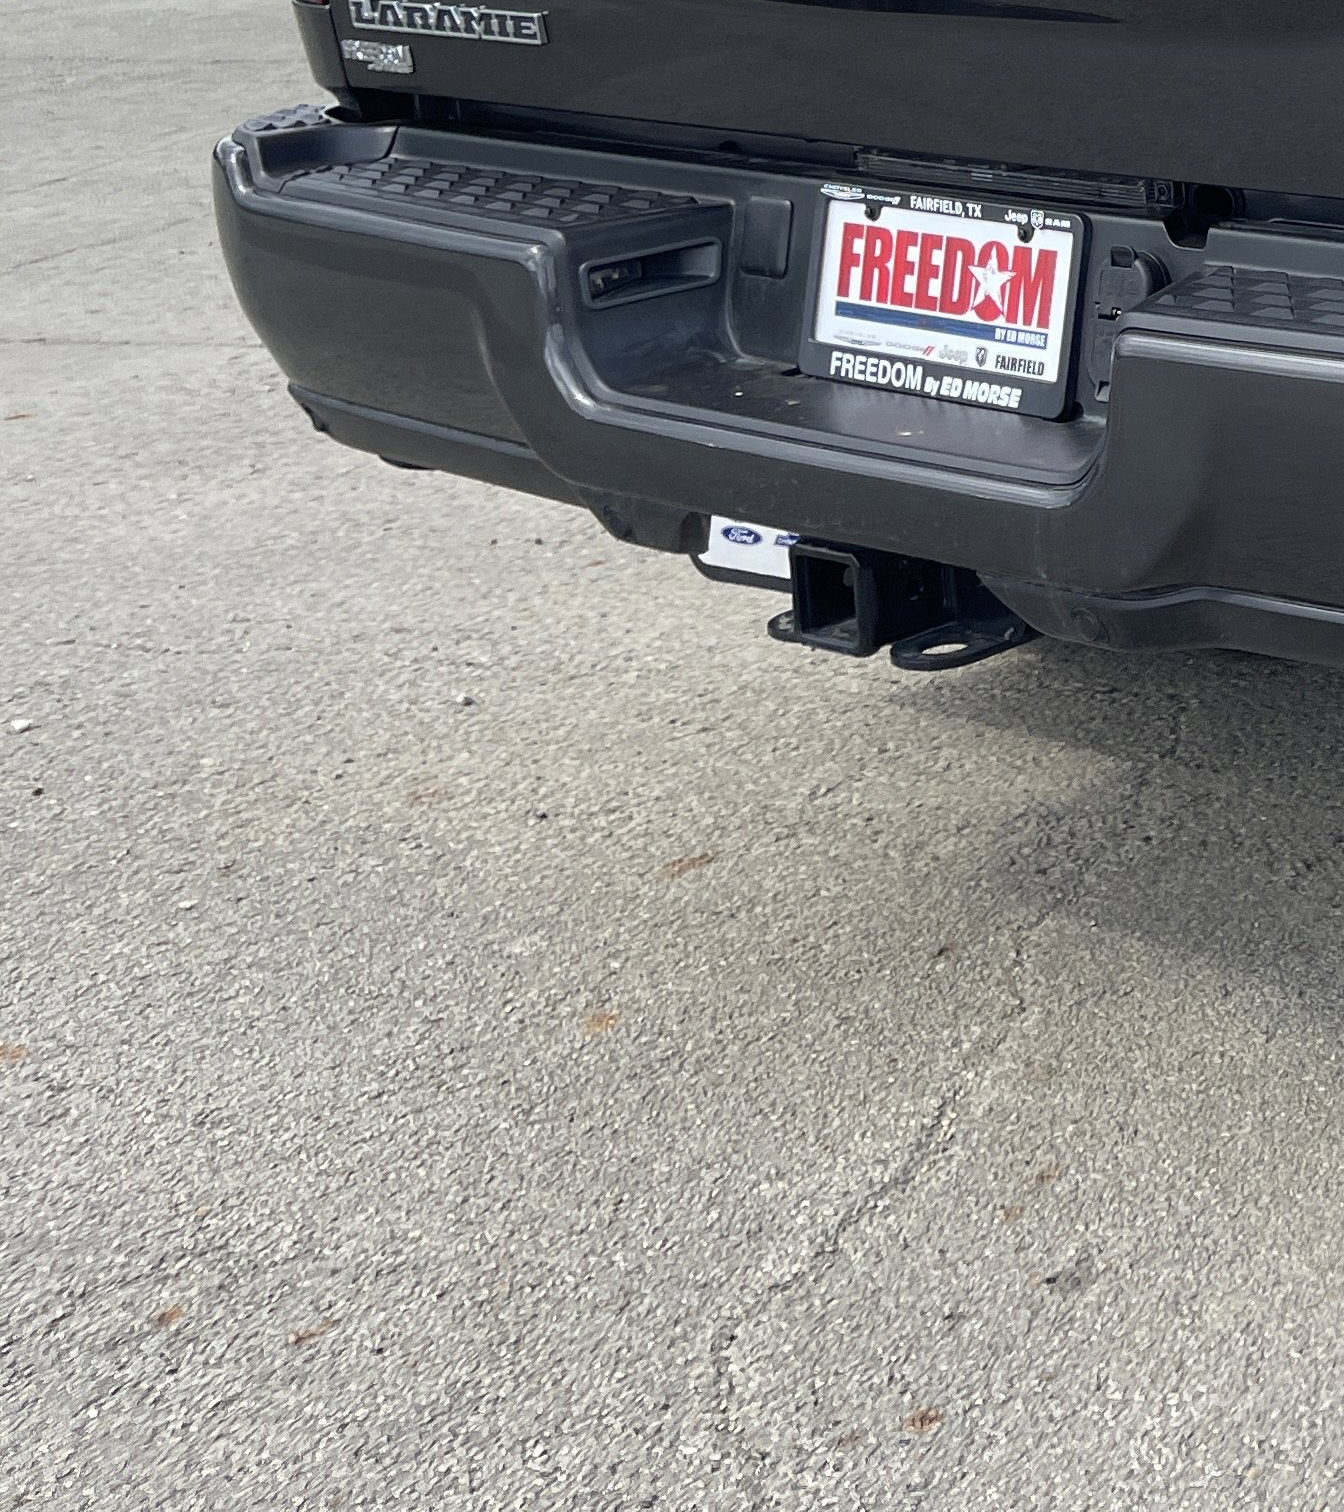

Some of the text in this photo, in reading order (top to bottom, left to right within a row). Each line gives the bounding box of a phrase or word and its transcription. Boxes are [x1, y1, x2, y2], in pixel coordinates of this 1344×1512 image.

[910, 195, 982, 218] FAIRFIELD, TX
[1004, 209, 1028, 225] Jeep
[1044, 217, 1071, 228] RAM
[837, 221, 1058, 329] FREEDOM
[995, 328, 1046, 347] BY ED MORSE
[995, 354, 1045, 376] FAIRFIELD
[829, 351, 924, 391] FREEDOM
[939, 375, 963, 398] ED
[962, 380, 1022, 409] MORSE
